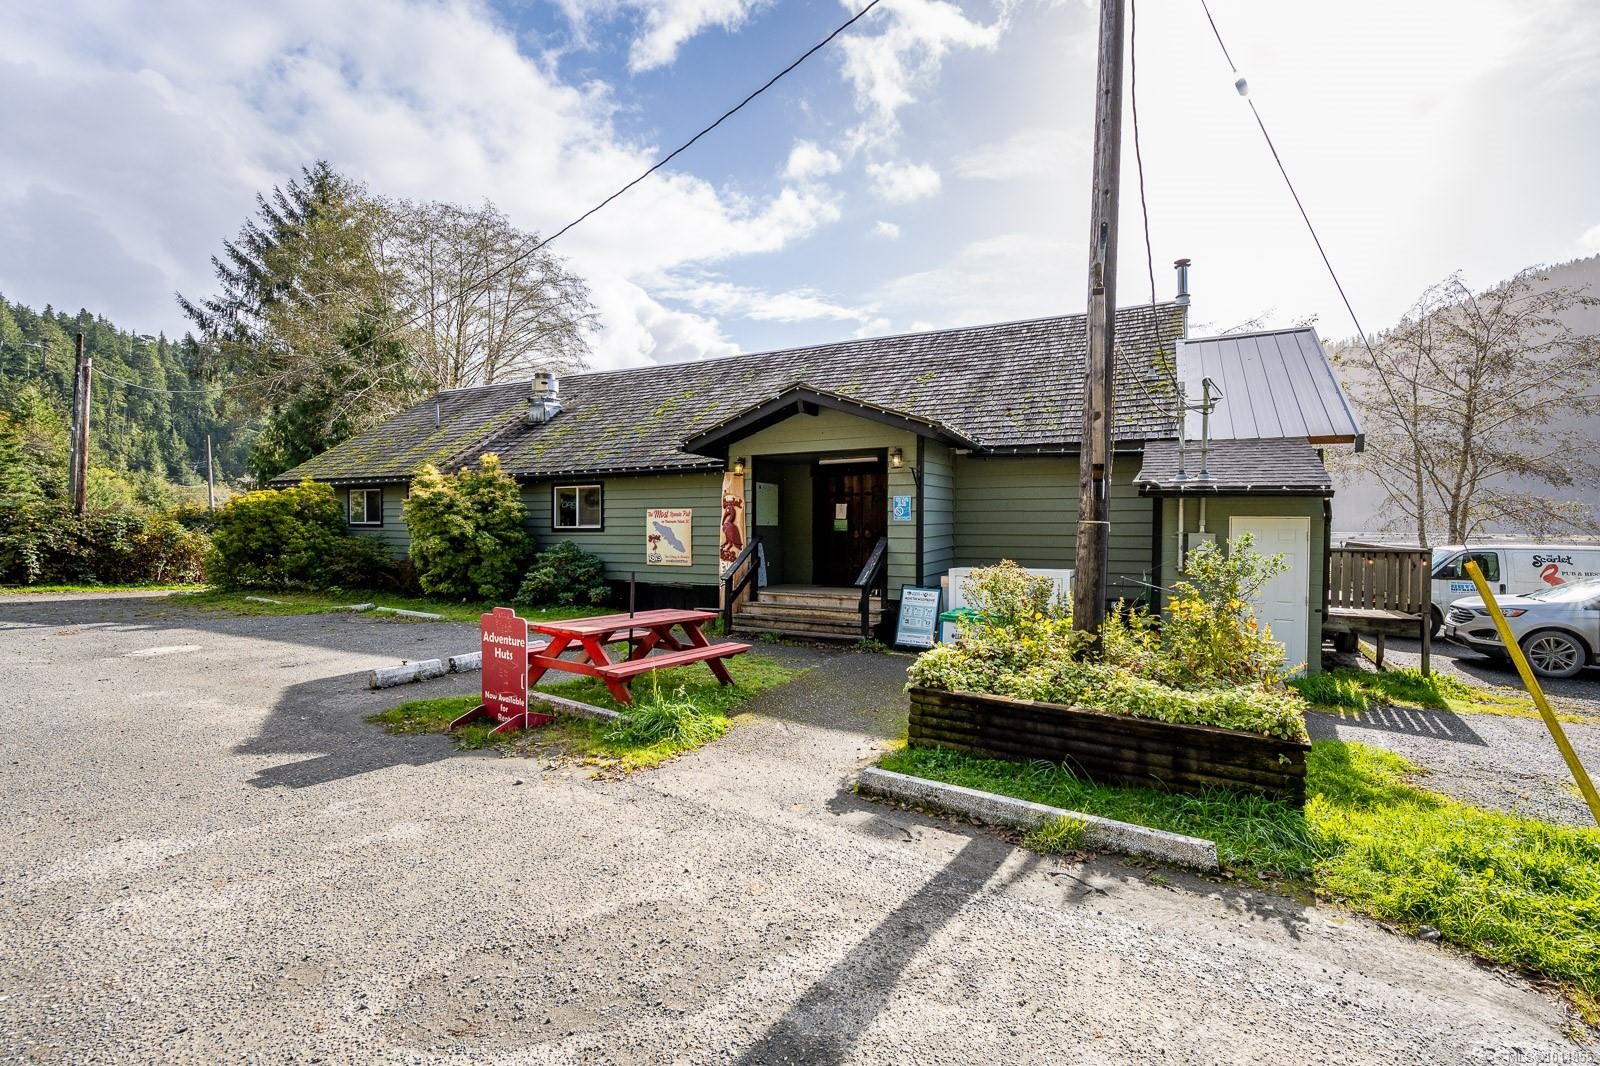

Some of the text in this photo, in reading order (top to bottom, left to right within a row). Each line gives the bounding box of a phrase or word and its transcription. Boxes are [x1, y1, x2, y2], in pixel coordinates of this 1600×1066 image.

[653, 510, 669, 518] Most
[1532, 554, 1574, 568] Scarlet
[483, 631, 525, 648] Adventure
[494, 647, 513, 660] Huts
[485, 691, 525, 707] Now Available
[500, 703, 508, 713] for
